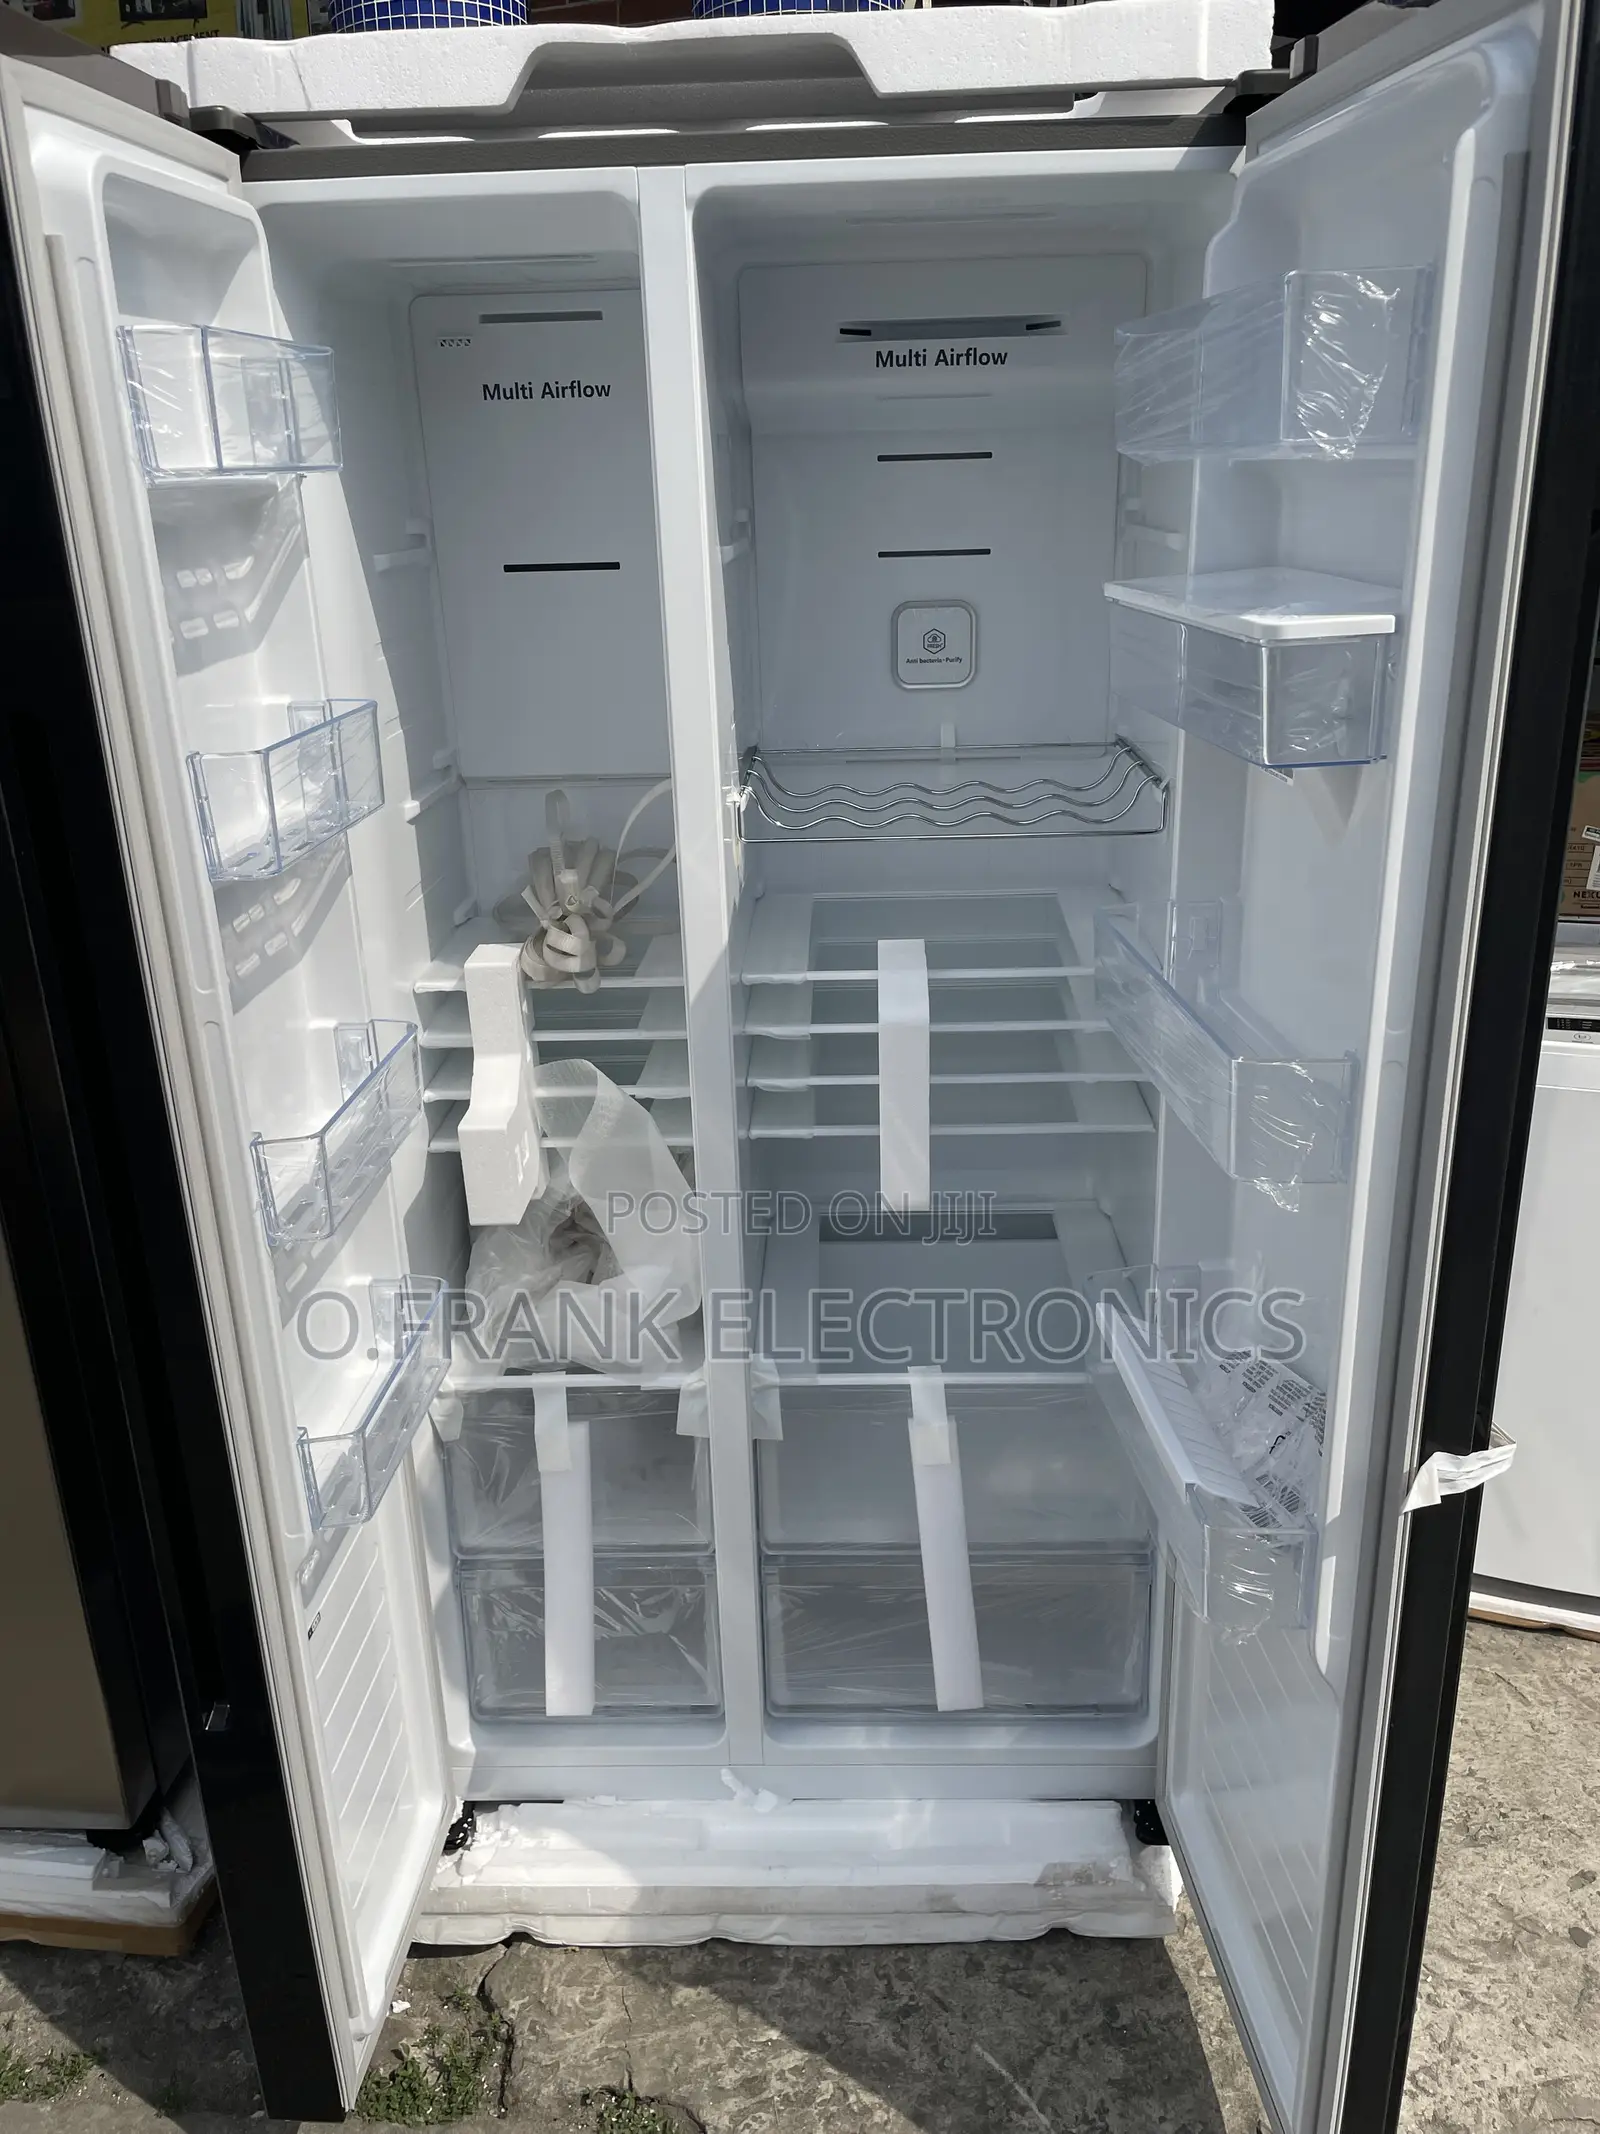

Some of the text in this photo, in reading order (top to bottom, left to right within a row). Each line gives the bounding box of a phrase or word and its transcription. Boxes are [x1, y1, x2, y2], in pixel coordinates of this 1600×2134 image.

[875, 347, 1008, 368] Multi Airflow
[482, 379, 611, 401] Multi Airflow
